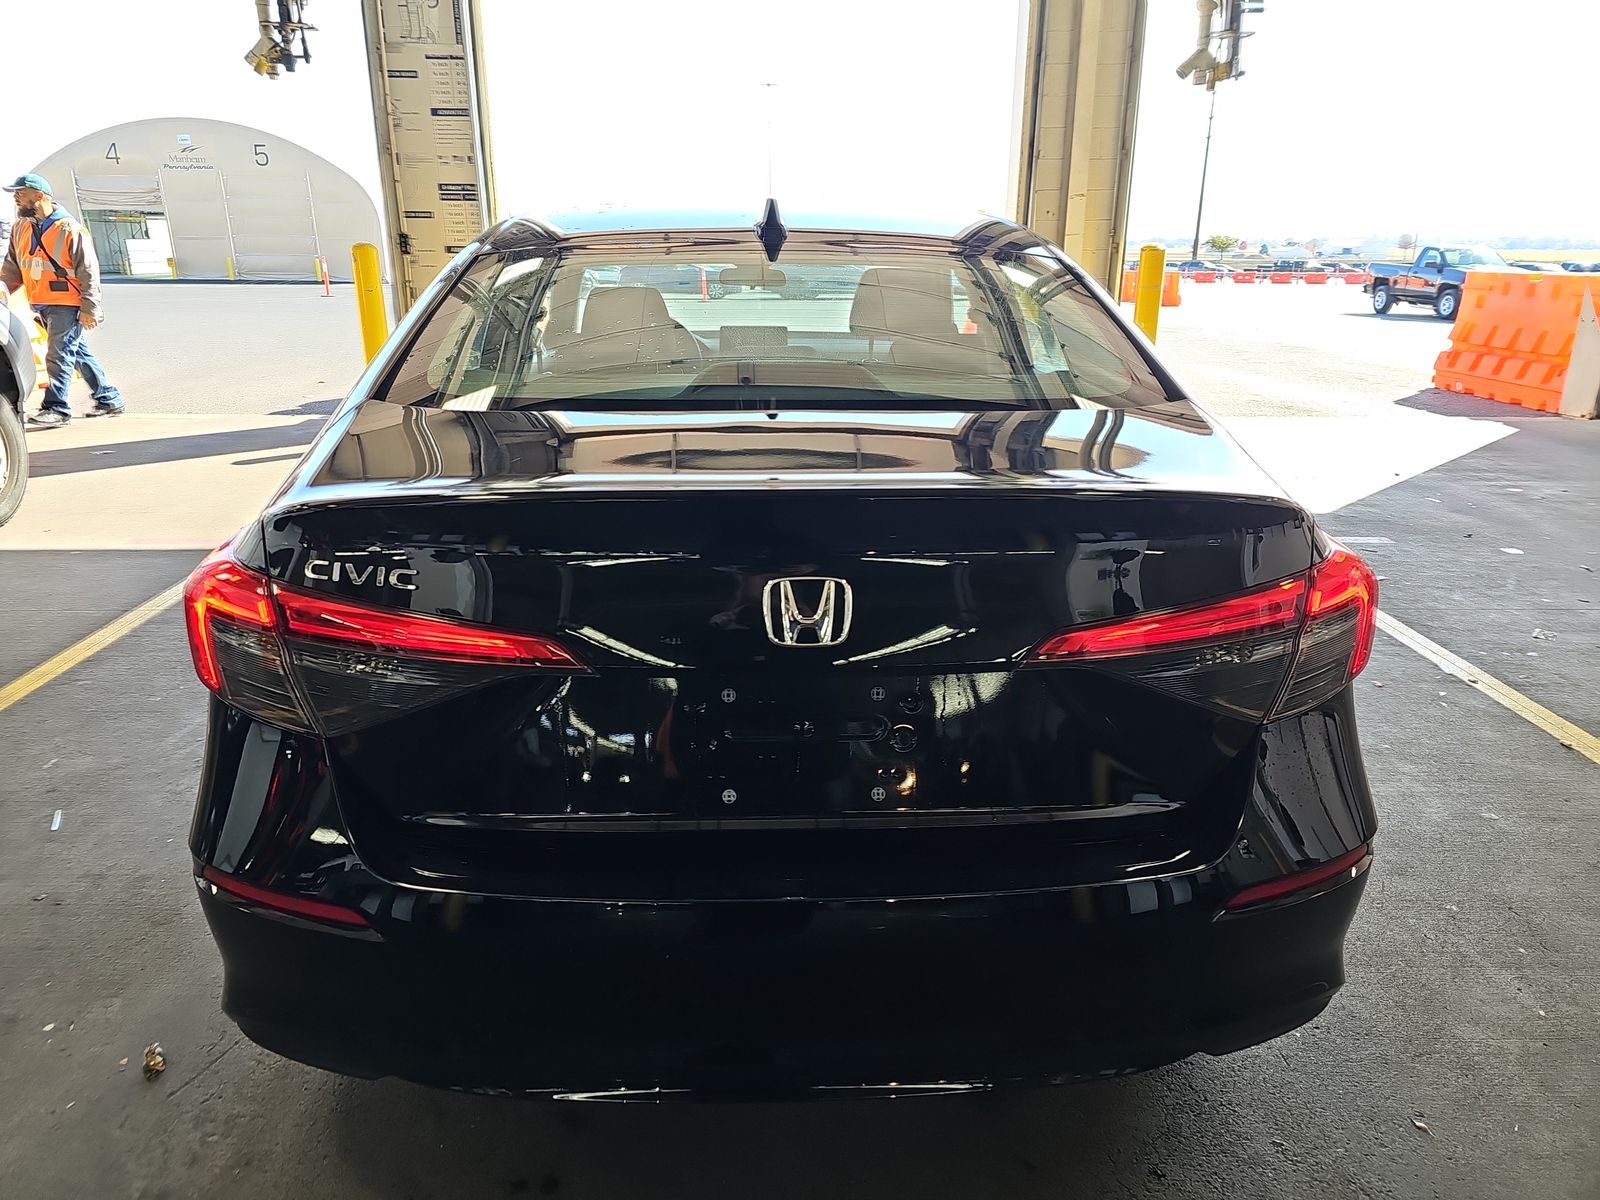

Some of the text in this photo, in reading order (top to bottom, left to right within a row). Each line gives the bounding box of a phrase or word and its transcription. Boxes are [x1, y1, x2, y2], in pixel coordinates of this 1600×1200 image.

[105, 142, 121, 165] 4
[167, 154, 207, 163] Manheim
[253, 144, 270, 167] 5
[163, 163, 215, 171] Pennsylvania
[304, 559, 418, 590] CIVIC
